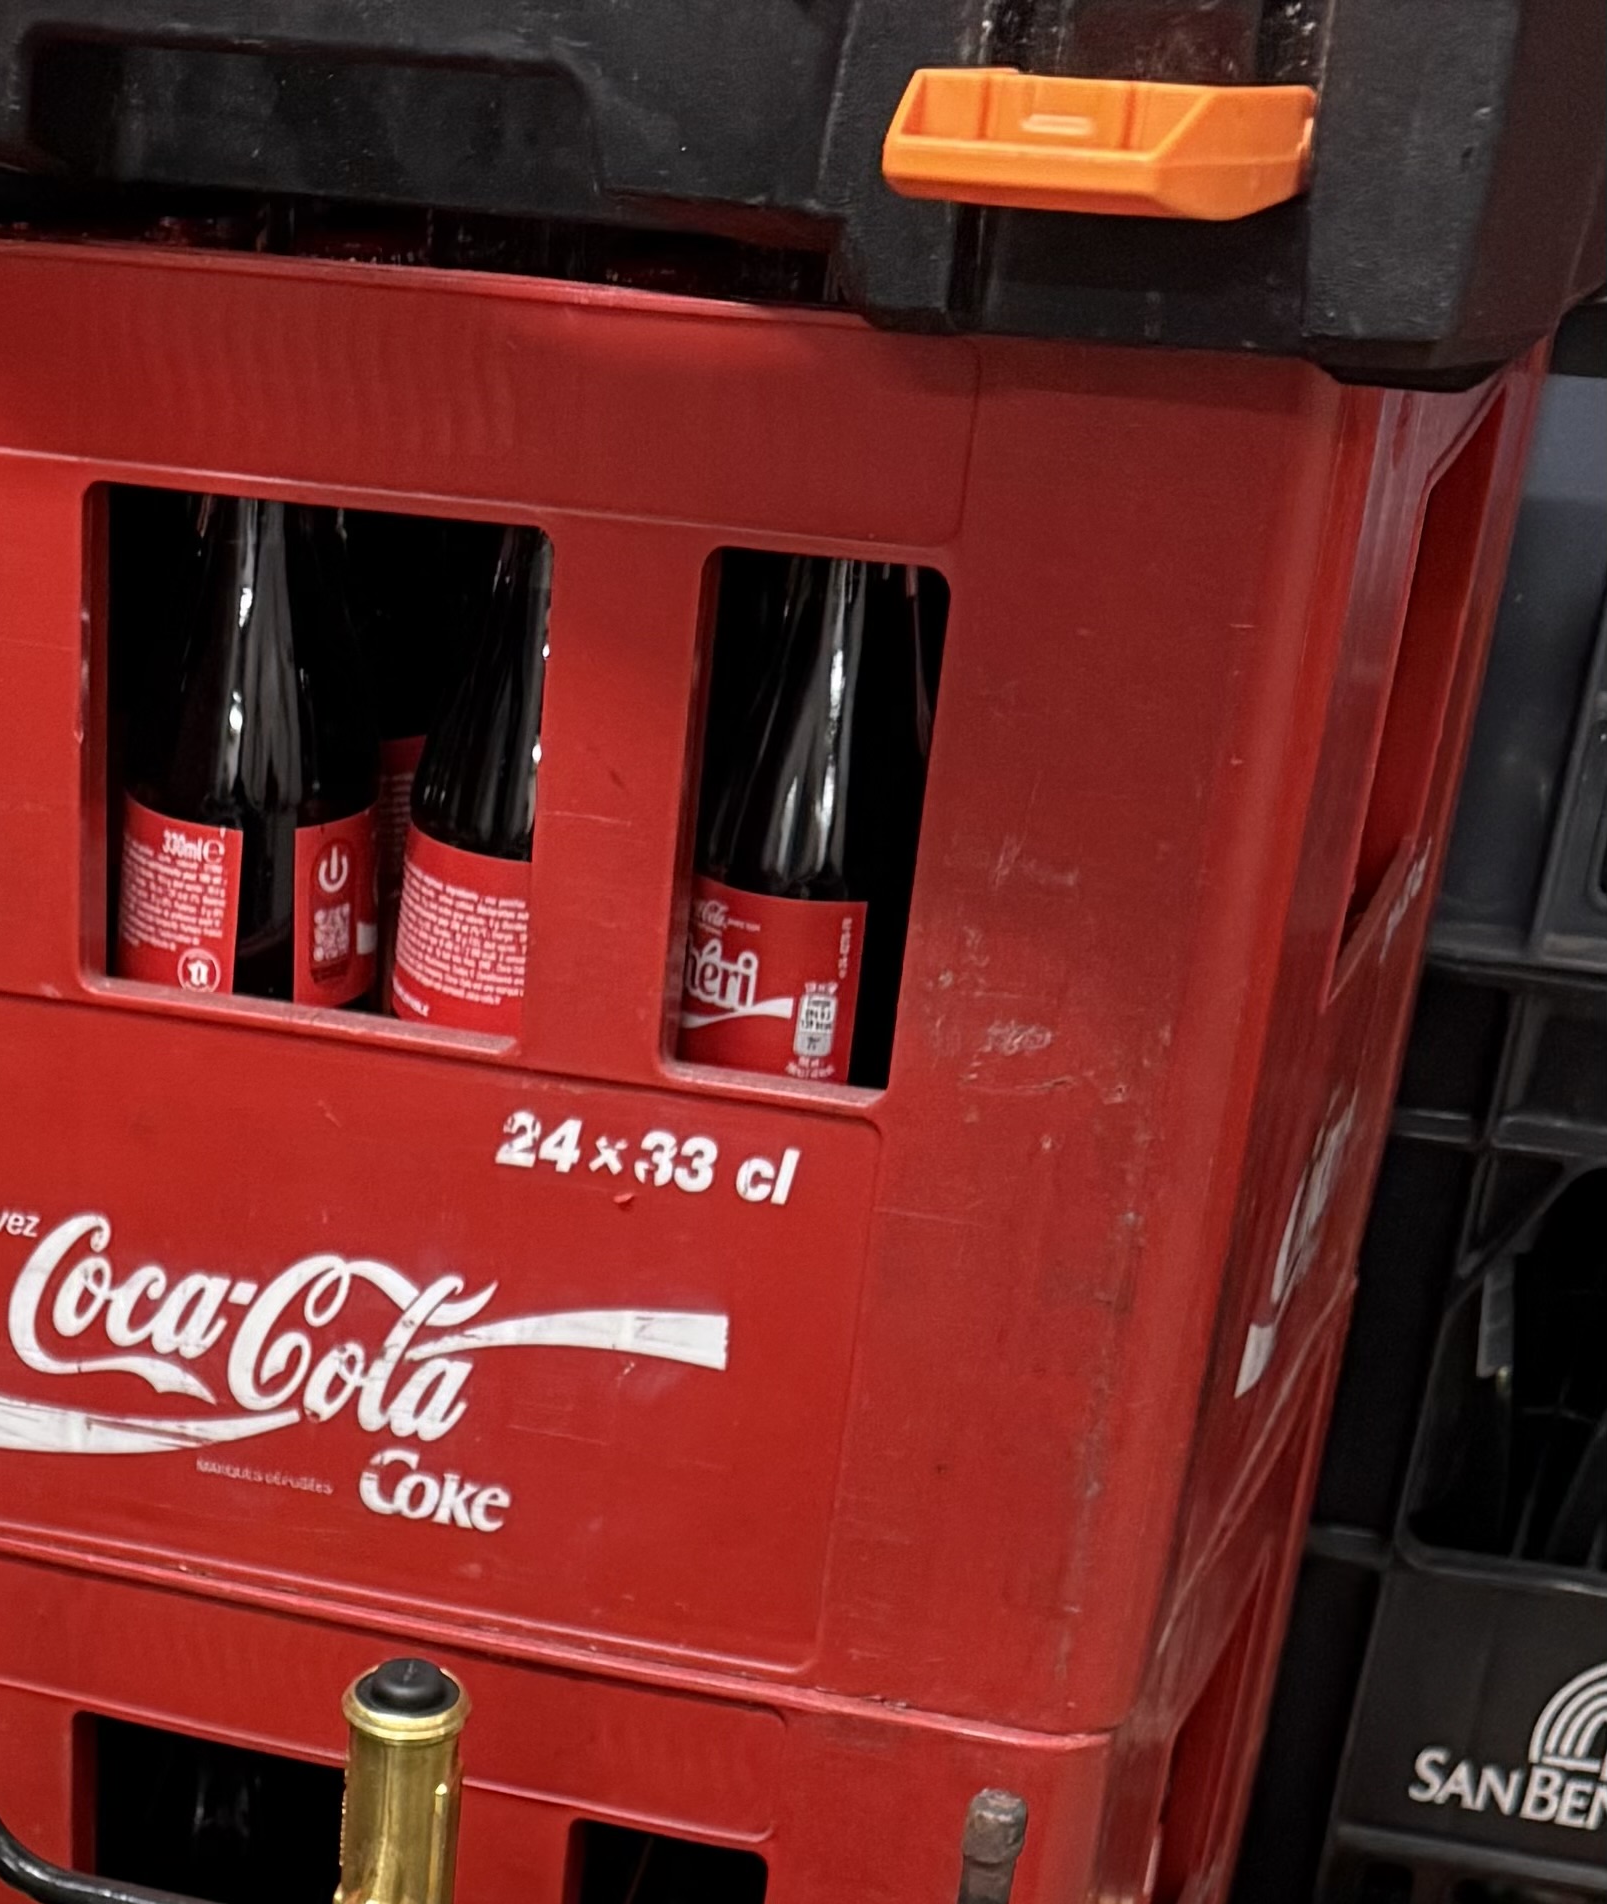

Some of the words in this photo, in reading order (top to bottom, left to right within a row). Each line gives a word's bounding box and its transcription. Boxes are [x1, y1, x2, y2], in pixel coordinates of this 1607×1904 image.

[735, 1147, 801, 1206] cl
[7, 1213, 499, 1442] Coca-Cola
[358, 1447, 511, 1533] Coke
